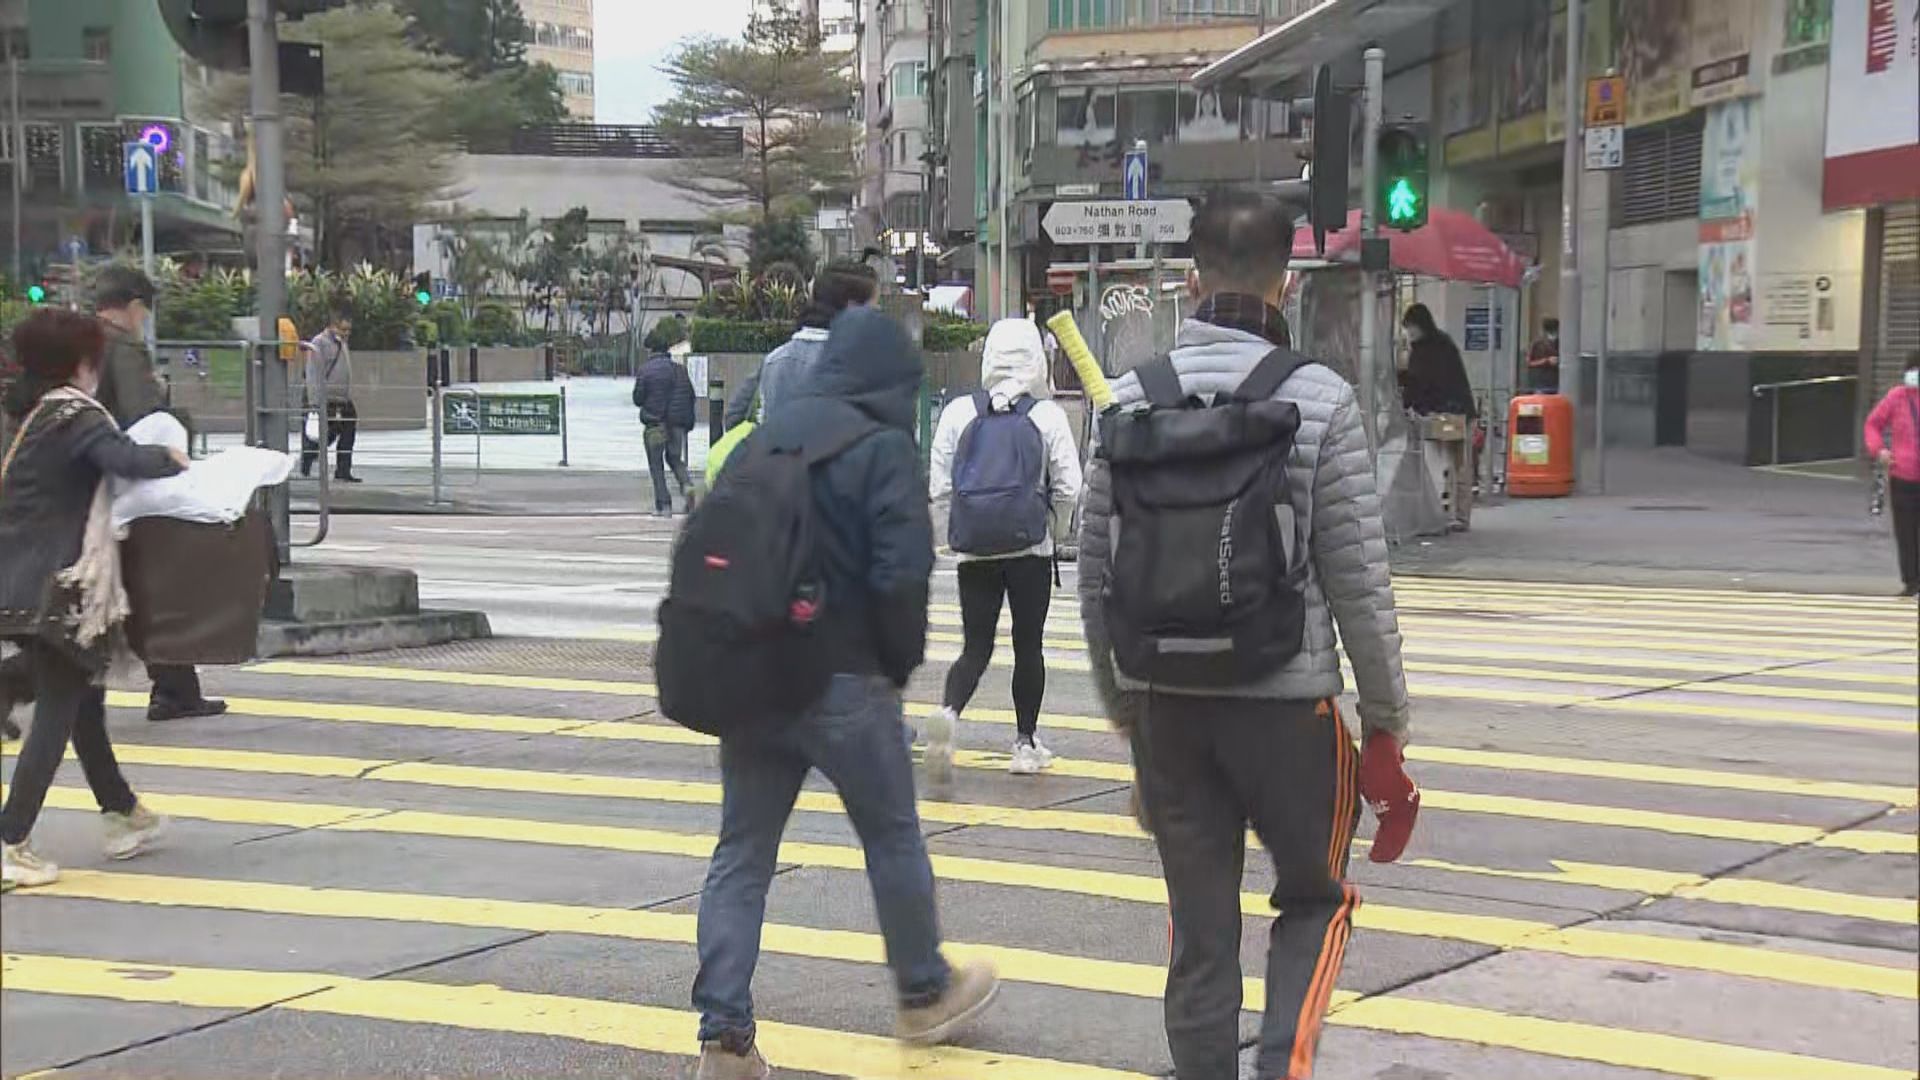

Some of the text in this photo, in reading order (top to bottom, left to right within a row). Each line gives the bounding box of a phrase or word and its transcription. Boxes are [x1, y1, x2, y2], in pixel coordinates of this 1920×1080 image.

[1084, 205, 1157, 218] Nathan Road
[488, 416, 552, 431] No Hawking
